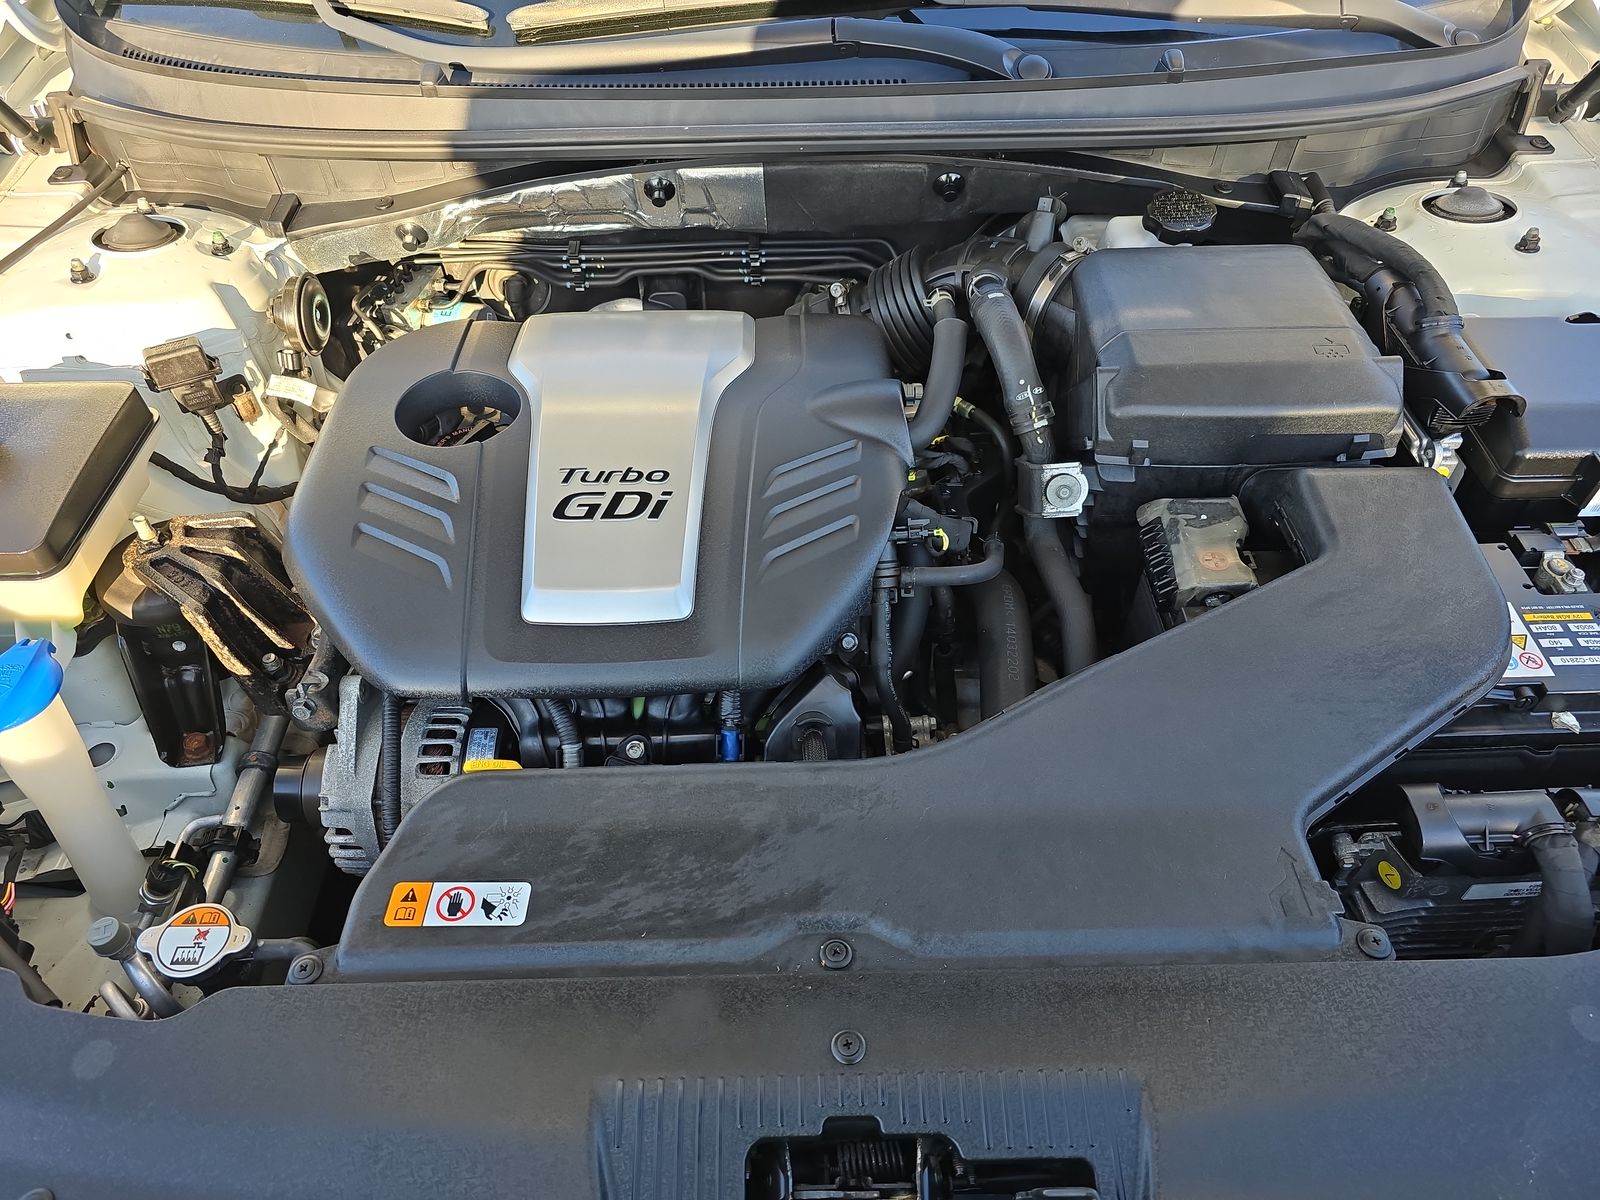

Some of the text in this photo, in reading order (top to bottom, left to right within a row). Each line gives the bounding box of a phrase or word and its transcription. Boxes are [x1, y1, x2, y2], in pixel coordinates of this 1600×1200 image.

[559, 466, 671, 485] Turbo
[552, 490, 674, 521] GDi
[1535, 624, 1558, 632] 80AH
